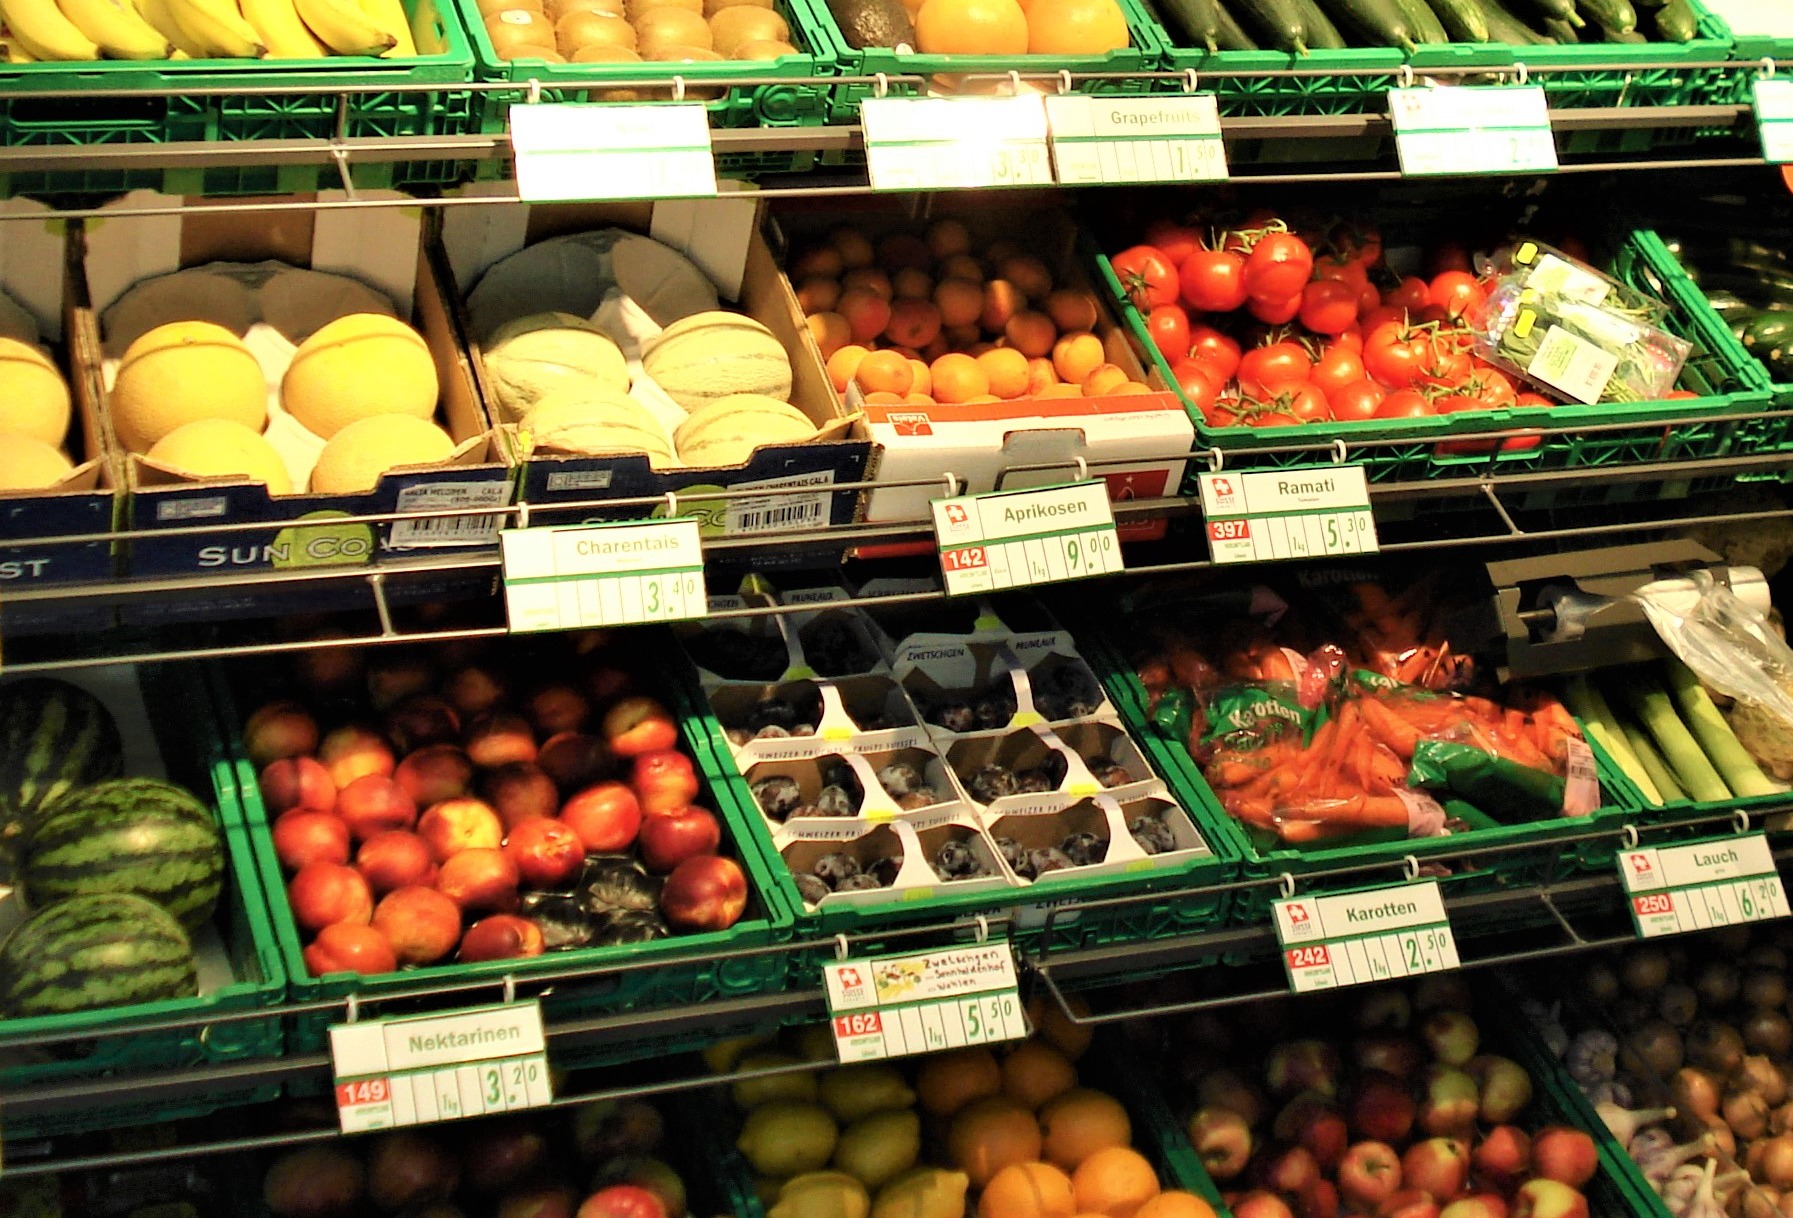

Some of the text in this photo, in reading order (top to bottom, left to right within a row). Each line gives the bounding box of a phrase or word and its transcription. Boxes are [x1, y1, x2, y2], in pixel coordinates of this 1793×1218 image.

[1110, 110, 1201, 127] Grapefruits
[1277, 479, 1336, 496] Ramati
[1004, 500, 1089, 524] Aprikosen
[1213, 520, 1246, 540] 397
[198, 542, 292, 567] SUN
[576, 535, 681, 557] Charentais
[948, 549, 986, 570] 142
[1693, 848, 1740, 868] Lauch
[1345, 901, 1418, 923] Karotten
[1639, 895, 1671, 914] 250
[1291, 947, 1327, 968] 242
[840, 1014, 879, 1036] 162
[407, 1025, 521, 1054] Nektarinen
[344, 1081, 387, 1104] 149
